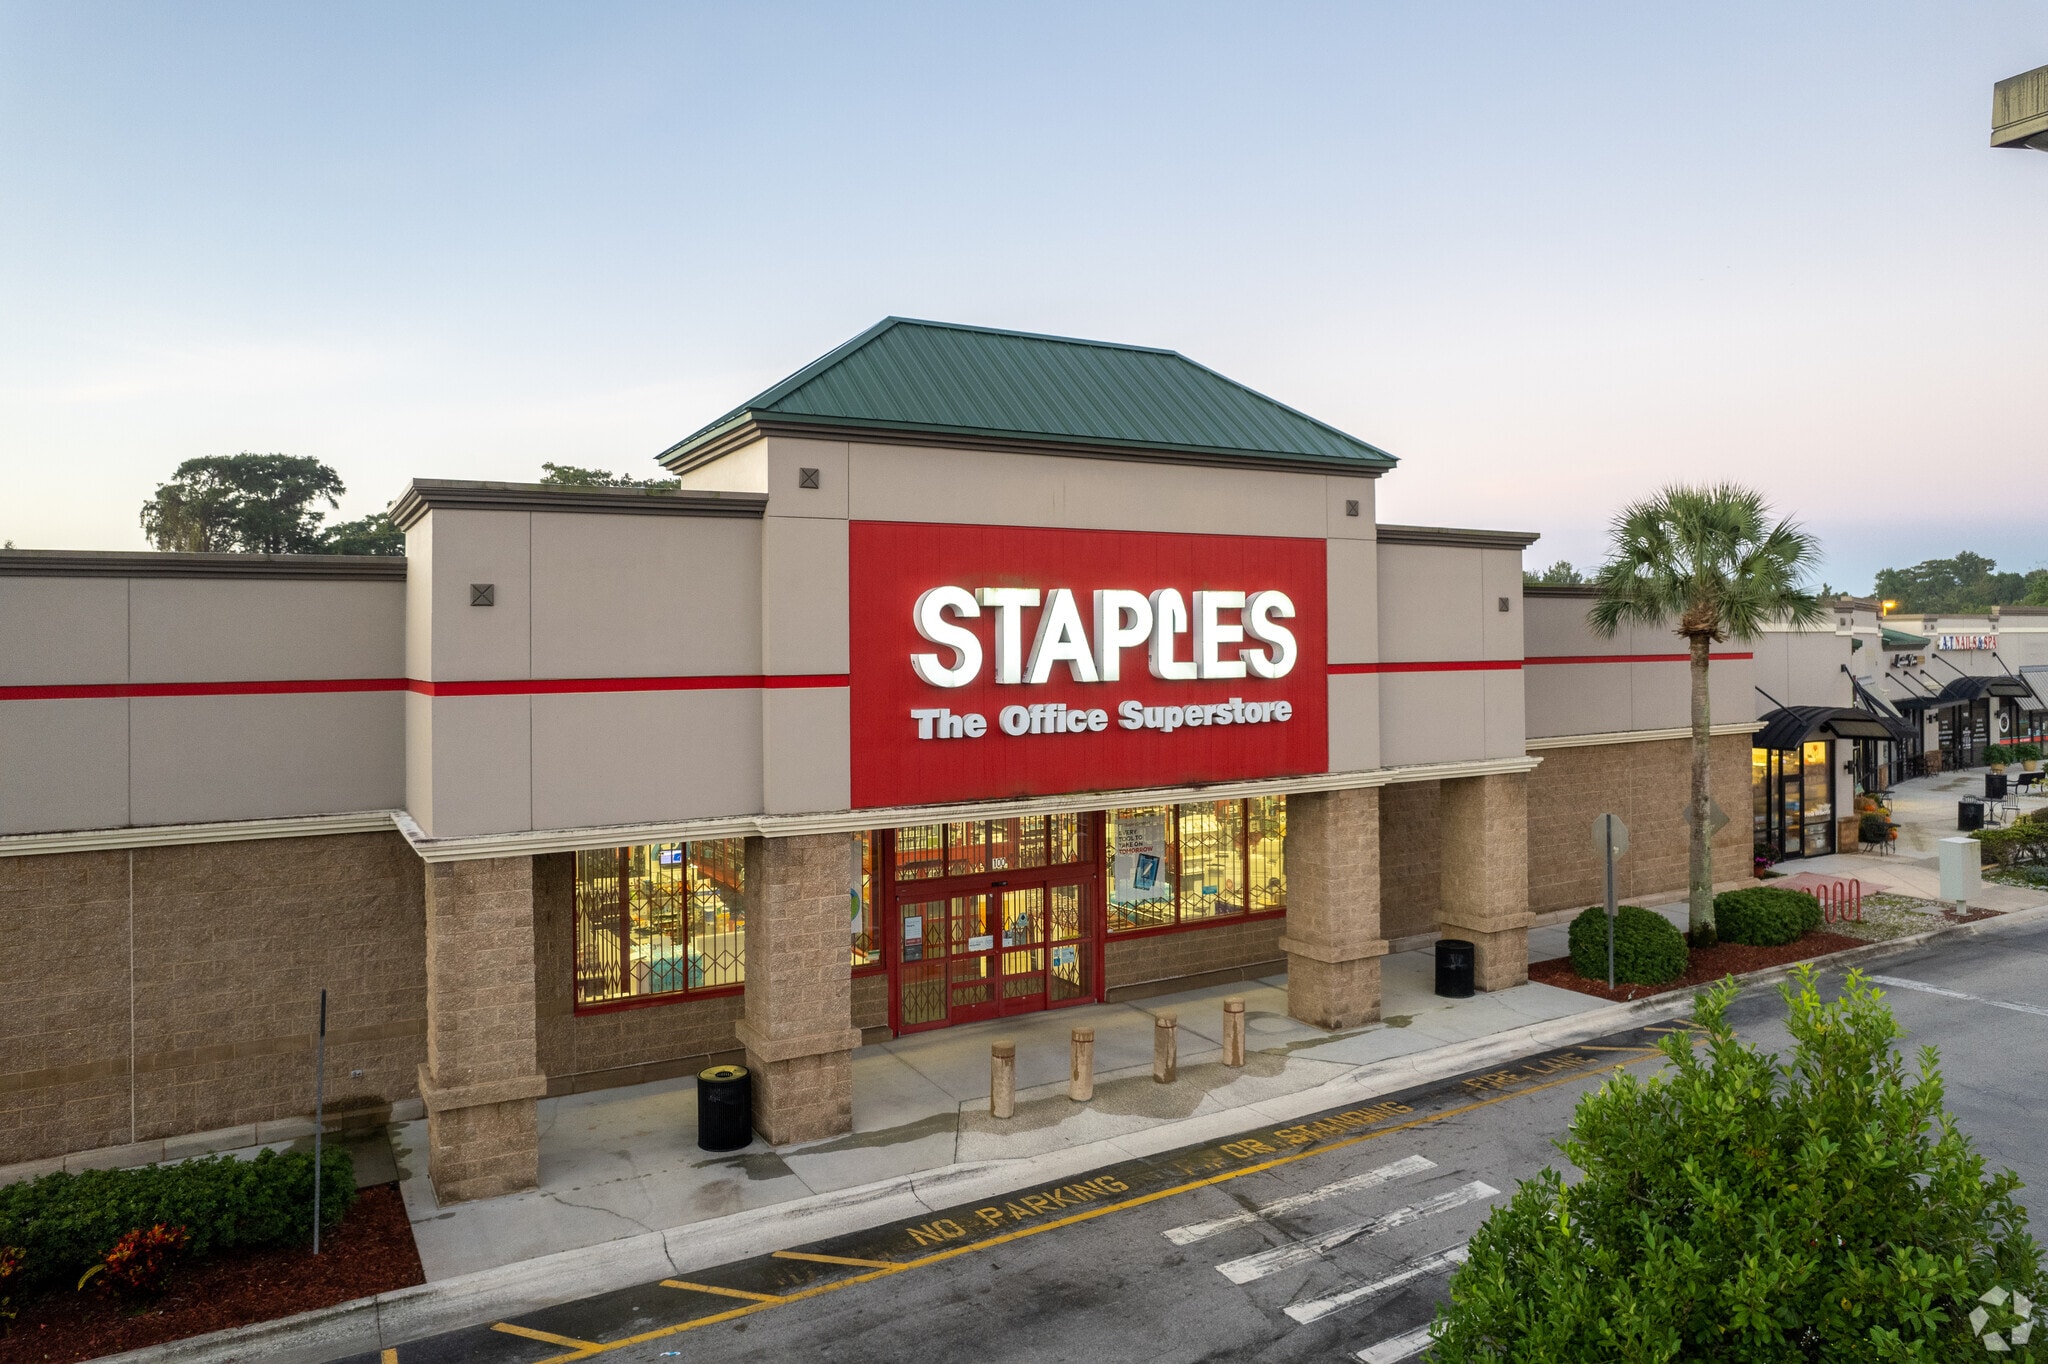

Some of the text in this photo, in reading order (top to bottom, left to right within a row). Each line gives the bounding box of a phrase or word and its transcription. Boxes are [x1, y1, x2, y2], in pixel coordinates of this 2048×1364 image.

[910, 585, 1297, 688] STAPLES
[1955, 636, 1977, 650] NAILS
[1978, 636, 1983, 650] &
[1984, 636, 1997, 650] SPA
[911, 697, 1293, 740] The Office Superstore
[905, 1052, 1599, 1246] NO PARKING OR STANDING FIRE LANE
